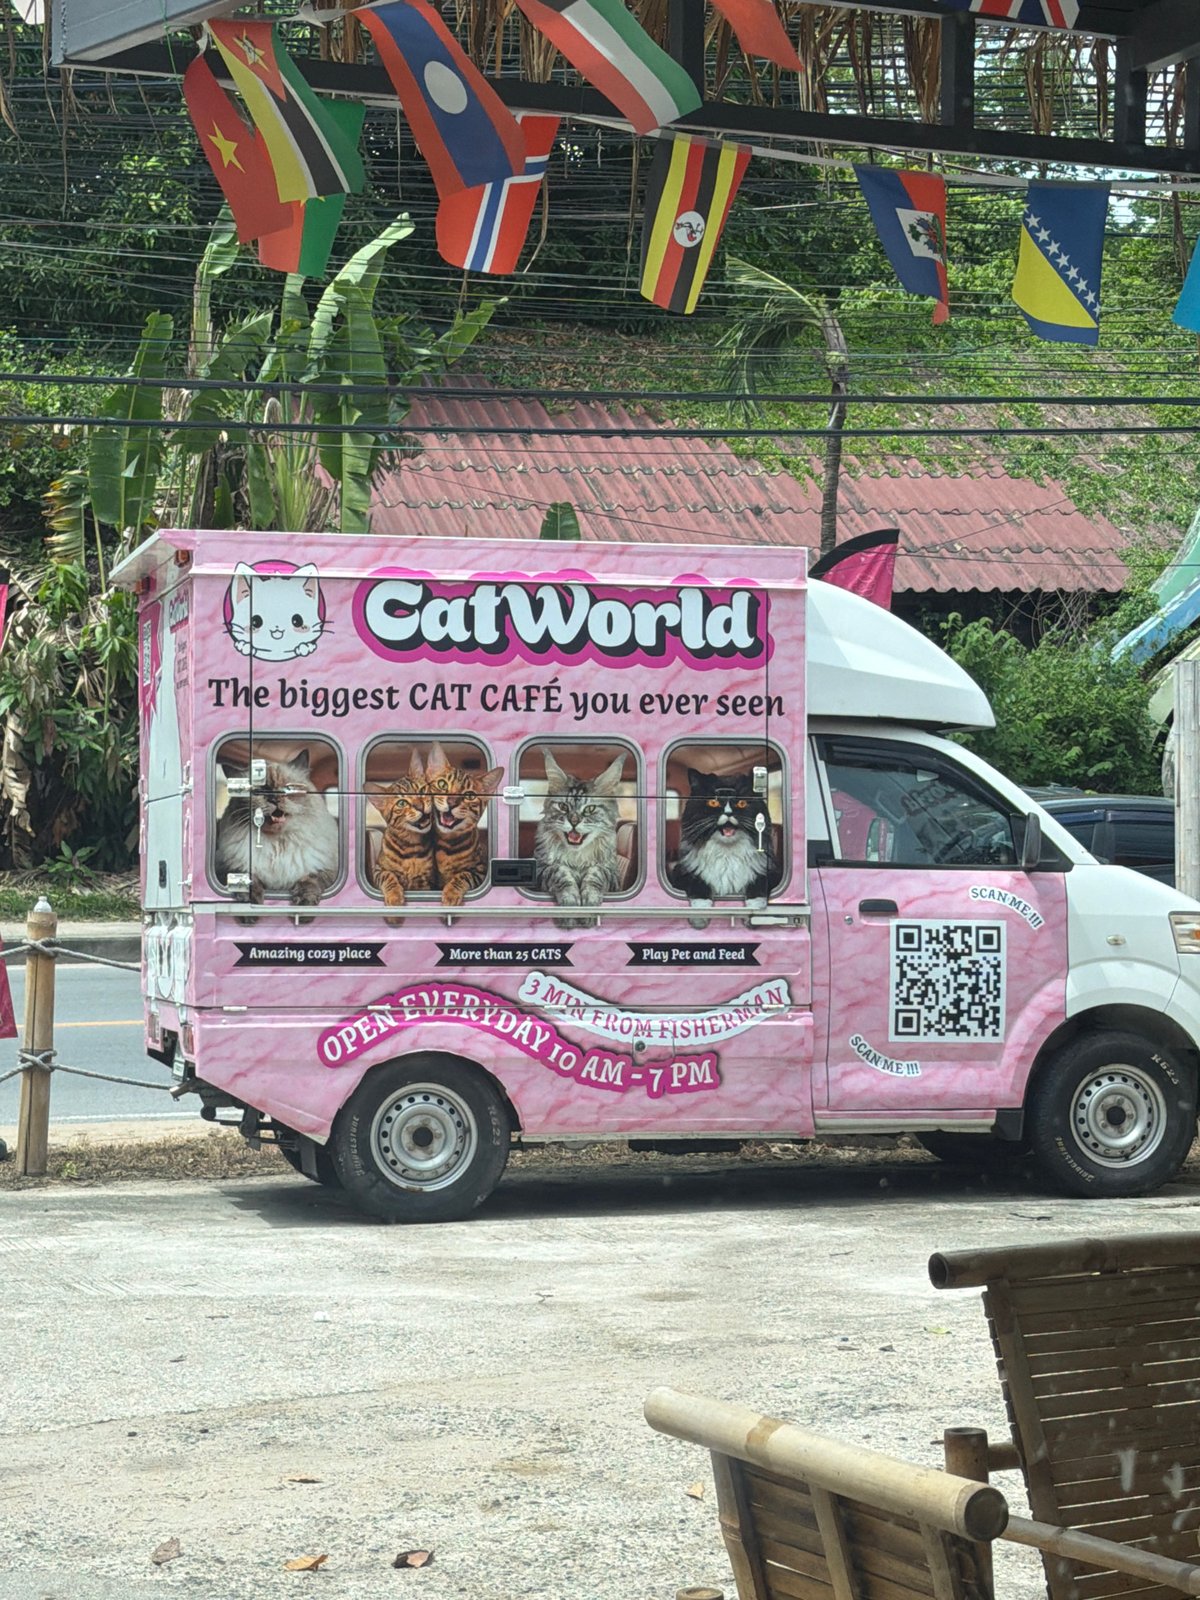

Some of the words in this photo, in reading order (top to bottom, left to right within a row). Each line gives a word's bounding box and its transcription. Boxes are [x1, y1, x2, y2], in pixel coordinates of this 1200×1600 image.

[364, 579, 763, 659] CatWorld
[208, 677, 270, 708] The
[278, 678, 400, 717] biggest
[409, 683, 472, 711] CAT
[480, 677, 562, 712] CAFÉ
[569, 691, 631, 721] you
[639, 693, 709, 715] ever
[715, 693, 785, 717] seen
[971, 888, 1008, 903] SCAN
[1008, 896, 1031, 916] ME
[249, 946, 305, 962] Amazing
[307, 949, 336, 962] cozy
[338, 946, 371, 962] place
[450, 948, 481, 960] More
[483, 947, 514, 960] than
[515, 950, 529, 961] 25
[531, 948, 562, 960] CATS
[642, 948, 669, 962] Play
[671, 948, 690, 960] Pet
[692, 948, 716, 960] and
[718, 948, 745, 960] Feed
[525, 979, 540, 996] 3
[541, 984, 586, 1021] MIN
[592, 1009, 653, 1039] FROM
[659, 986, 785, 1039] FISHERMAN
[323, 1005, 399, 1062] OPEN
[400, 990, 550, 1052] EVERYDAY
[547, 1043, 577, 1070] 10
[581, 1055, 624, 1086] AM
[649, 1068, 663, 1092] 7
[670, 1059, 714, 1087] PM
[851, 1036, 881, 1067] SCAN
[882, 1059, 903, 1074] ME
[1055, 1137, 1096, 1183] BRIDGESTONE
